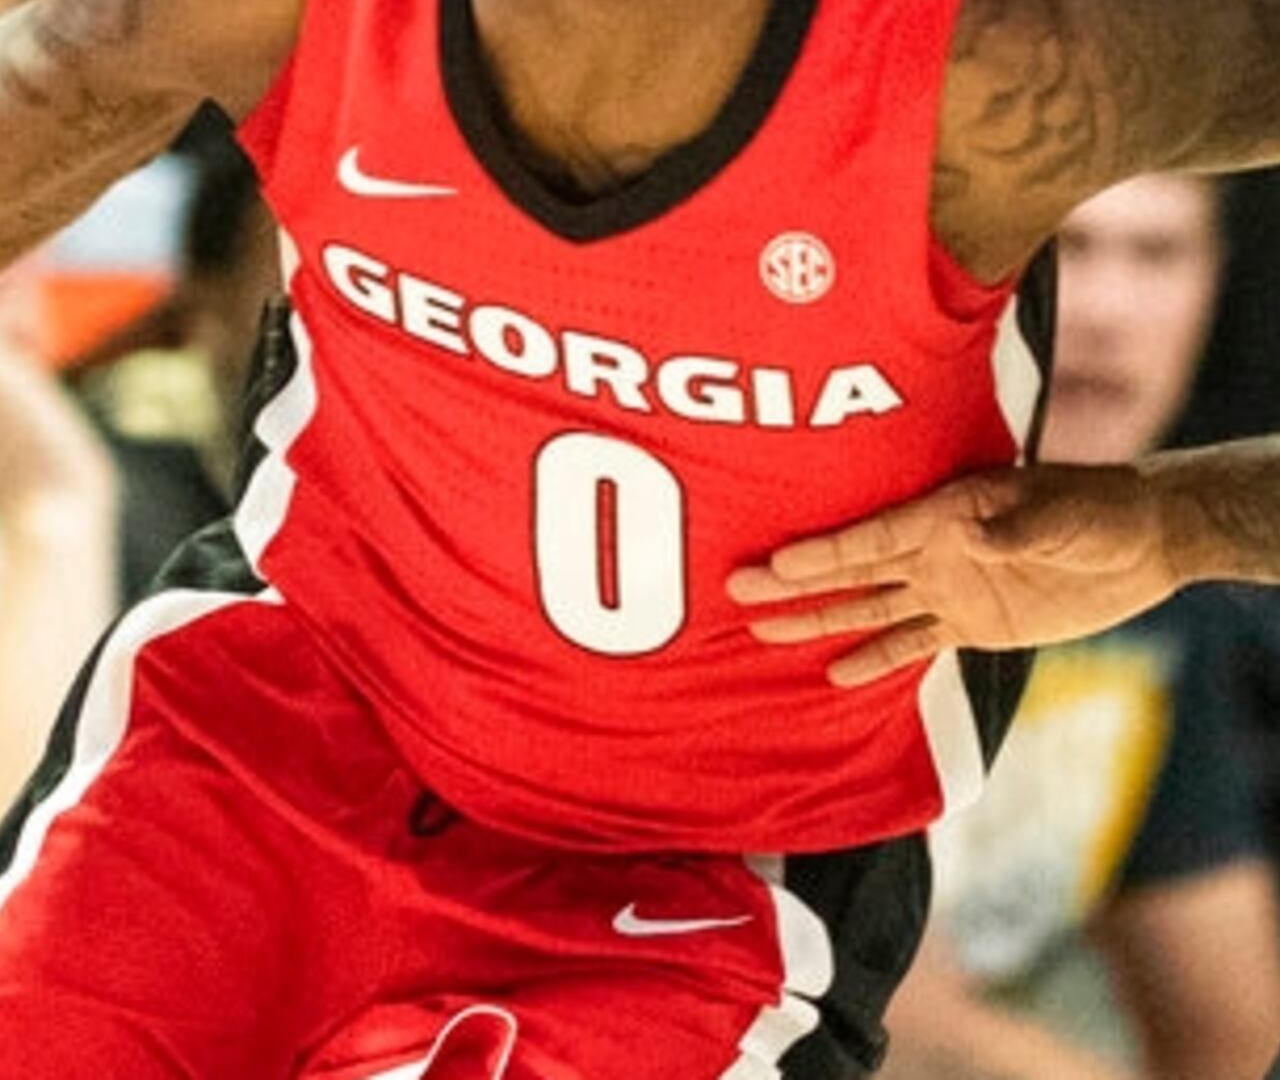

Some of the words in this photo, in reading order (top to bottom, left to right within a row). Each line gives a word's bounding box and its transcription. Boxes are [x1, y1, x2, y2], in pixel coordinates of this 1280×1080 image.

[322, 243, 904, 428] GEORGIA
[764, 240, 830, 297] SEC
[531, 430, 687, 657] 0
